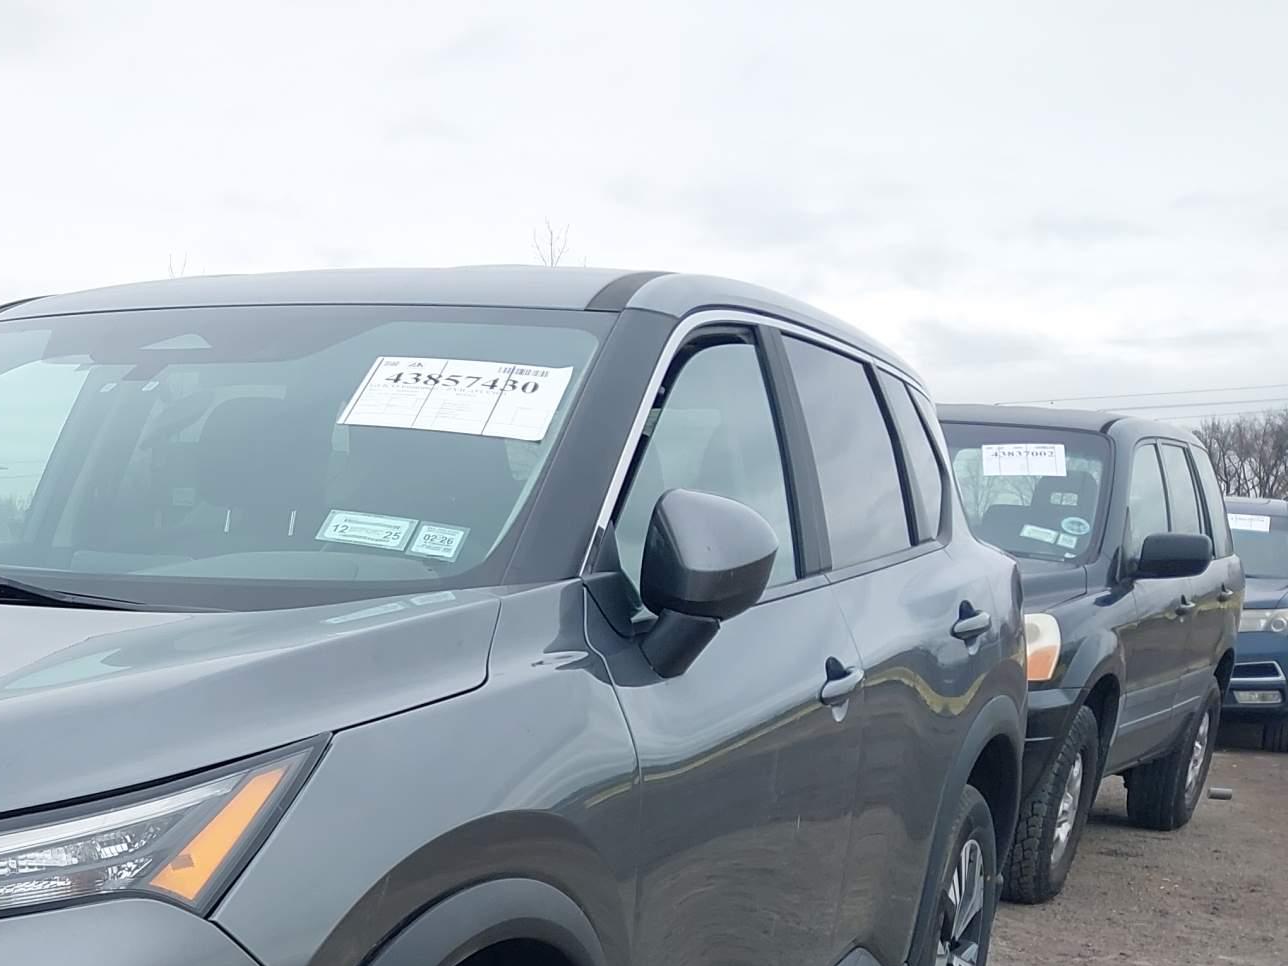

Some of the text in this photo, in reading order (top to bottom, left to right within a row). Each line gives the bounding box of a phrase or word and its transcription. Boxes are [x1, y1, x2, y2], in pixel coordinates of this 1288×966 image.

[384, 372, 540, 394] 43857430
[333, 524, 349, 534] 12
[383, 531, 401, 541] 25
